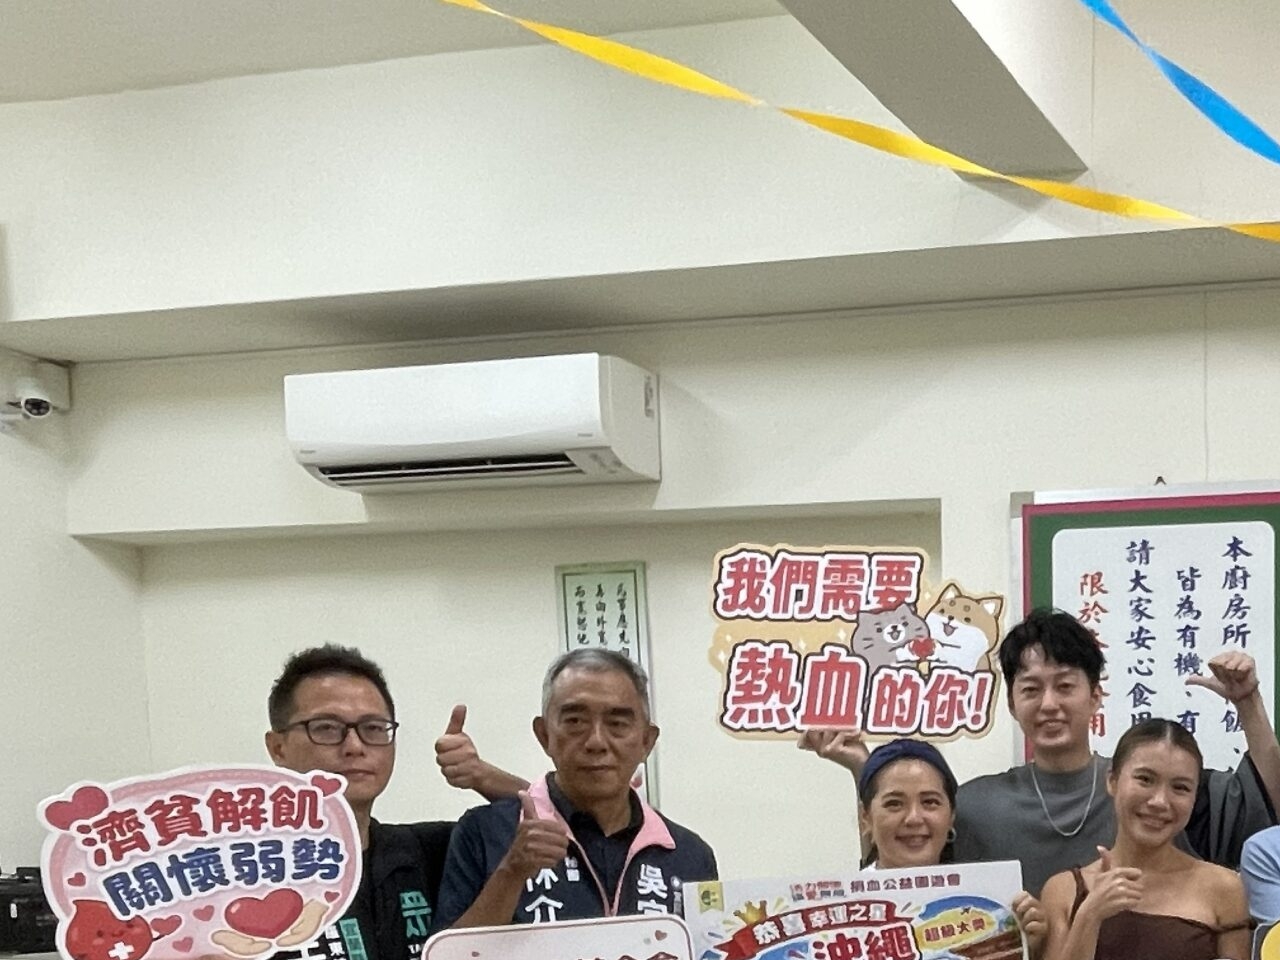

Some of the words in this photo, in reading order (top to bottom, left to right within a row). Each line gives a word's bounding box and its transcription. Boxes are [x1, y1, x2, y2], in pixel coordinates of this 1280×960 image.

[721, 556, 913, 615] 我們需要
[729, 647, 993, 728] 熱血的你!
[77, 785, 323, 867] 濟貧解飢
[103, 838, 344, 916] 關懷弱勢
